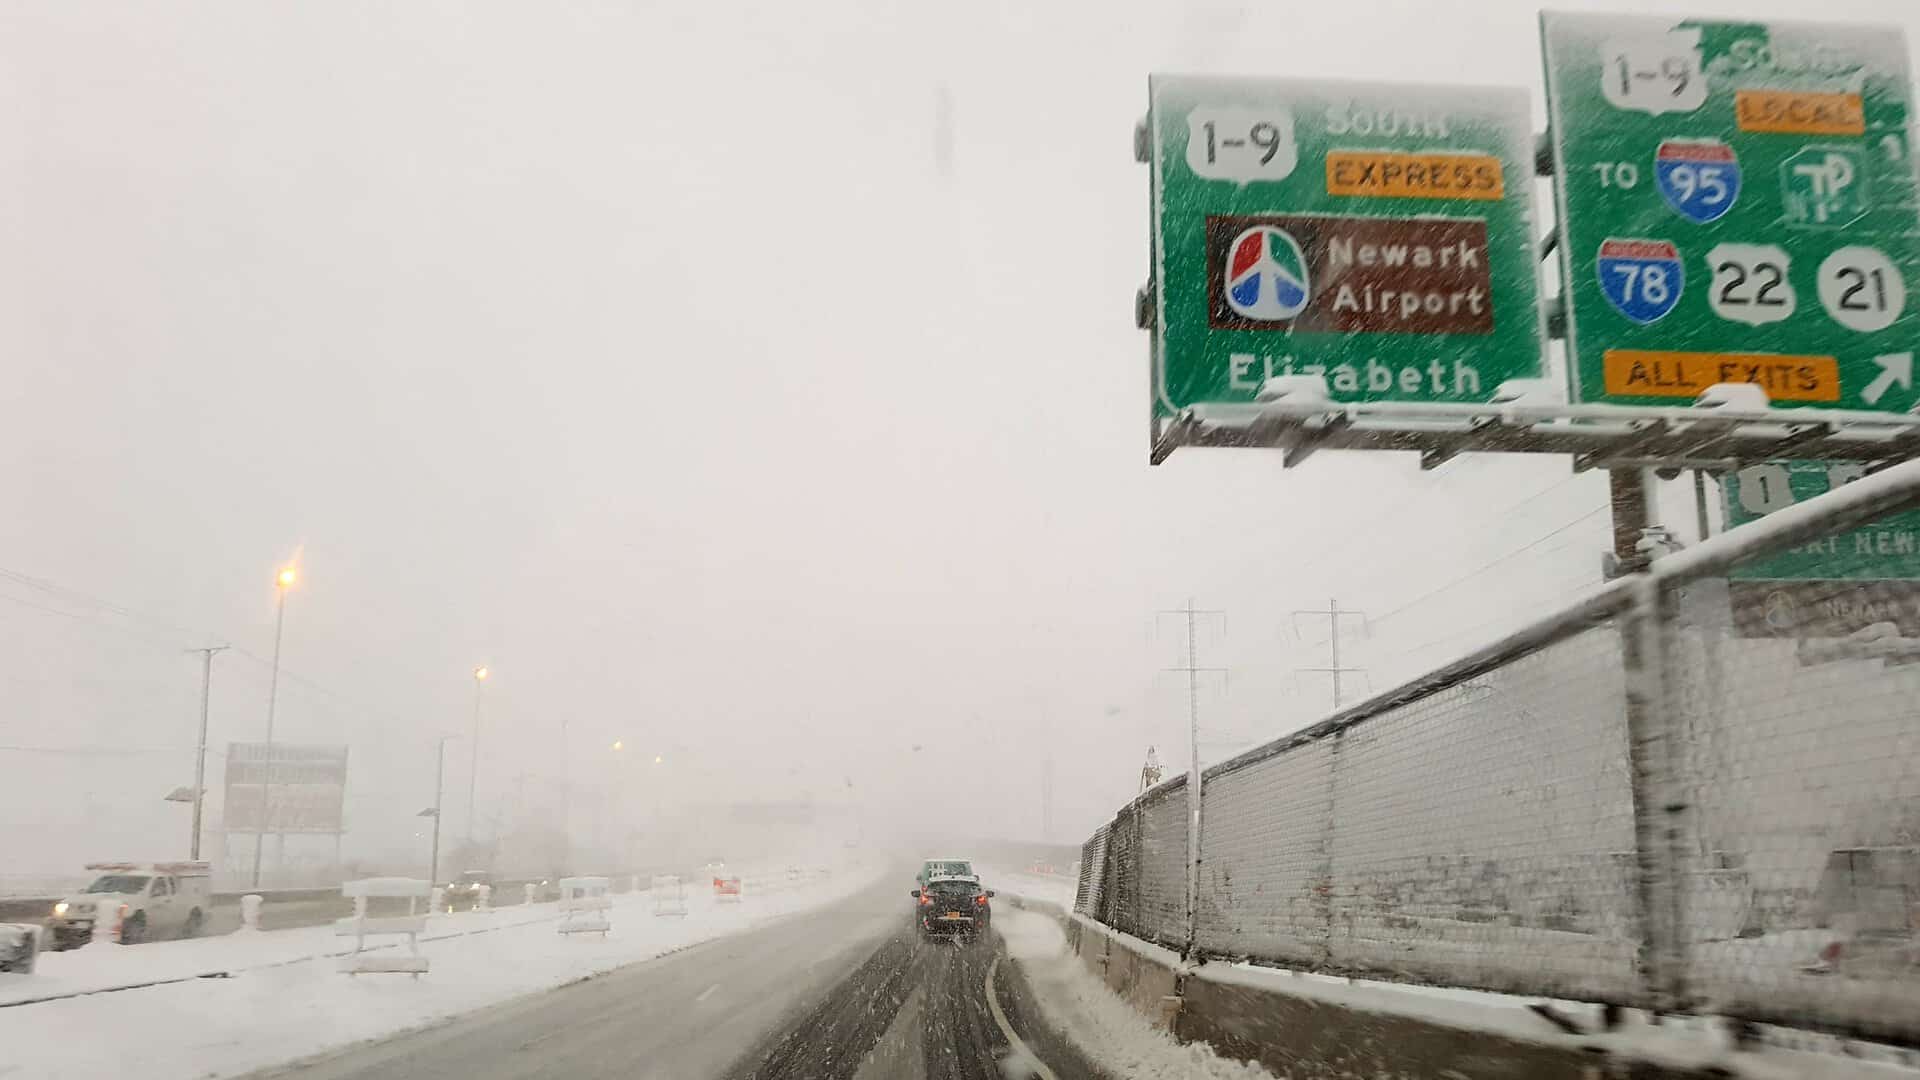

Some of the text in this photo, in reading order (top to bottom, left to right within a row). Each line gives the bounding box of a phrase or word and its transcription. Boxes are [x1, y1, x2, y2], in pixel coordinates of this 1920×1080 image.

[1614, 54, 1690, 97] 1-9
[1201, 119, 1281, 166] 1-9
[1333, 159, 1498, 193] EXPRESS
[1593, 161, 1639, 191] TO
[1669, 165, 1728, 205] 95
[1328, 236, 1480, 269] Newark
[1613, 264, 1670, 305] 78
[1716, 261, 1787, 307] 22
[1833, 266, 1888, 313] 21
[1331, 285, 1485, 320] Airport
[1626, 360, 1698, 388] ALL
[1759, 475, 1770, 504] 1
[1856, 531, 1920, 554] NEW
